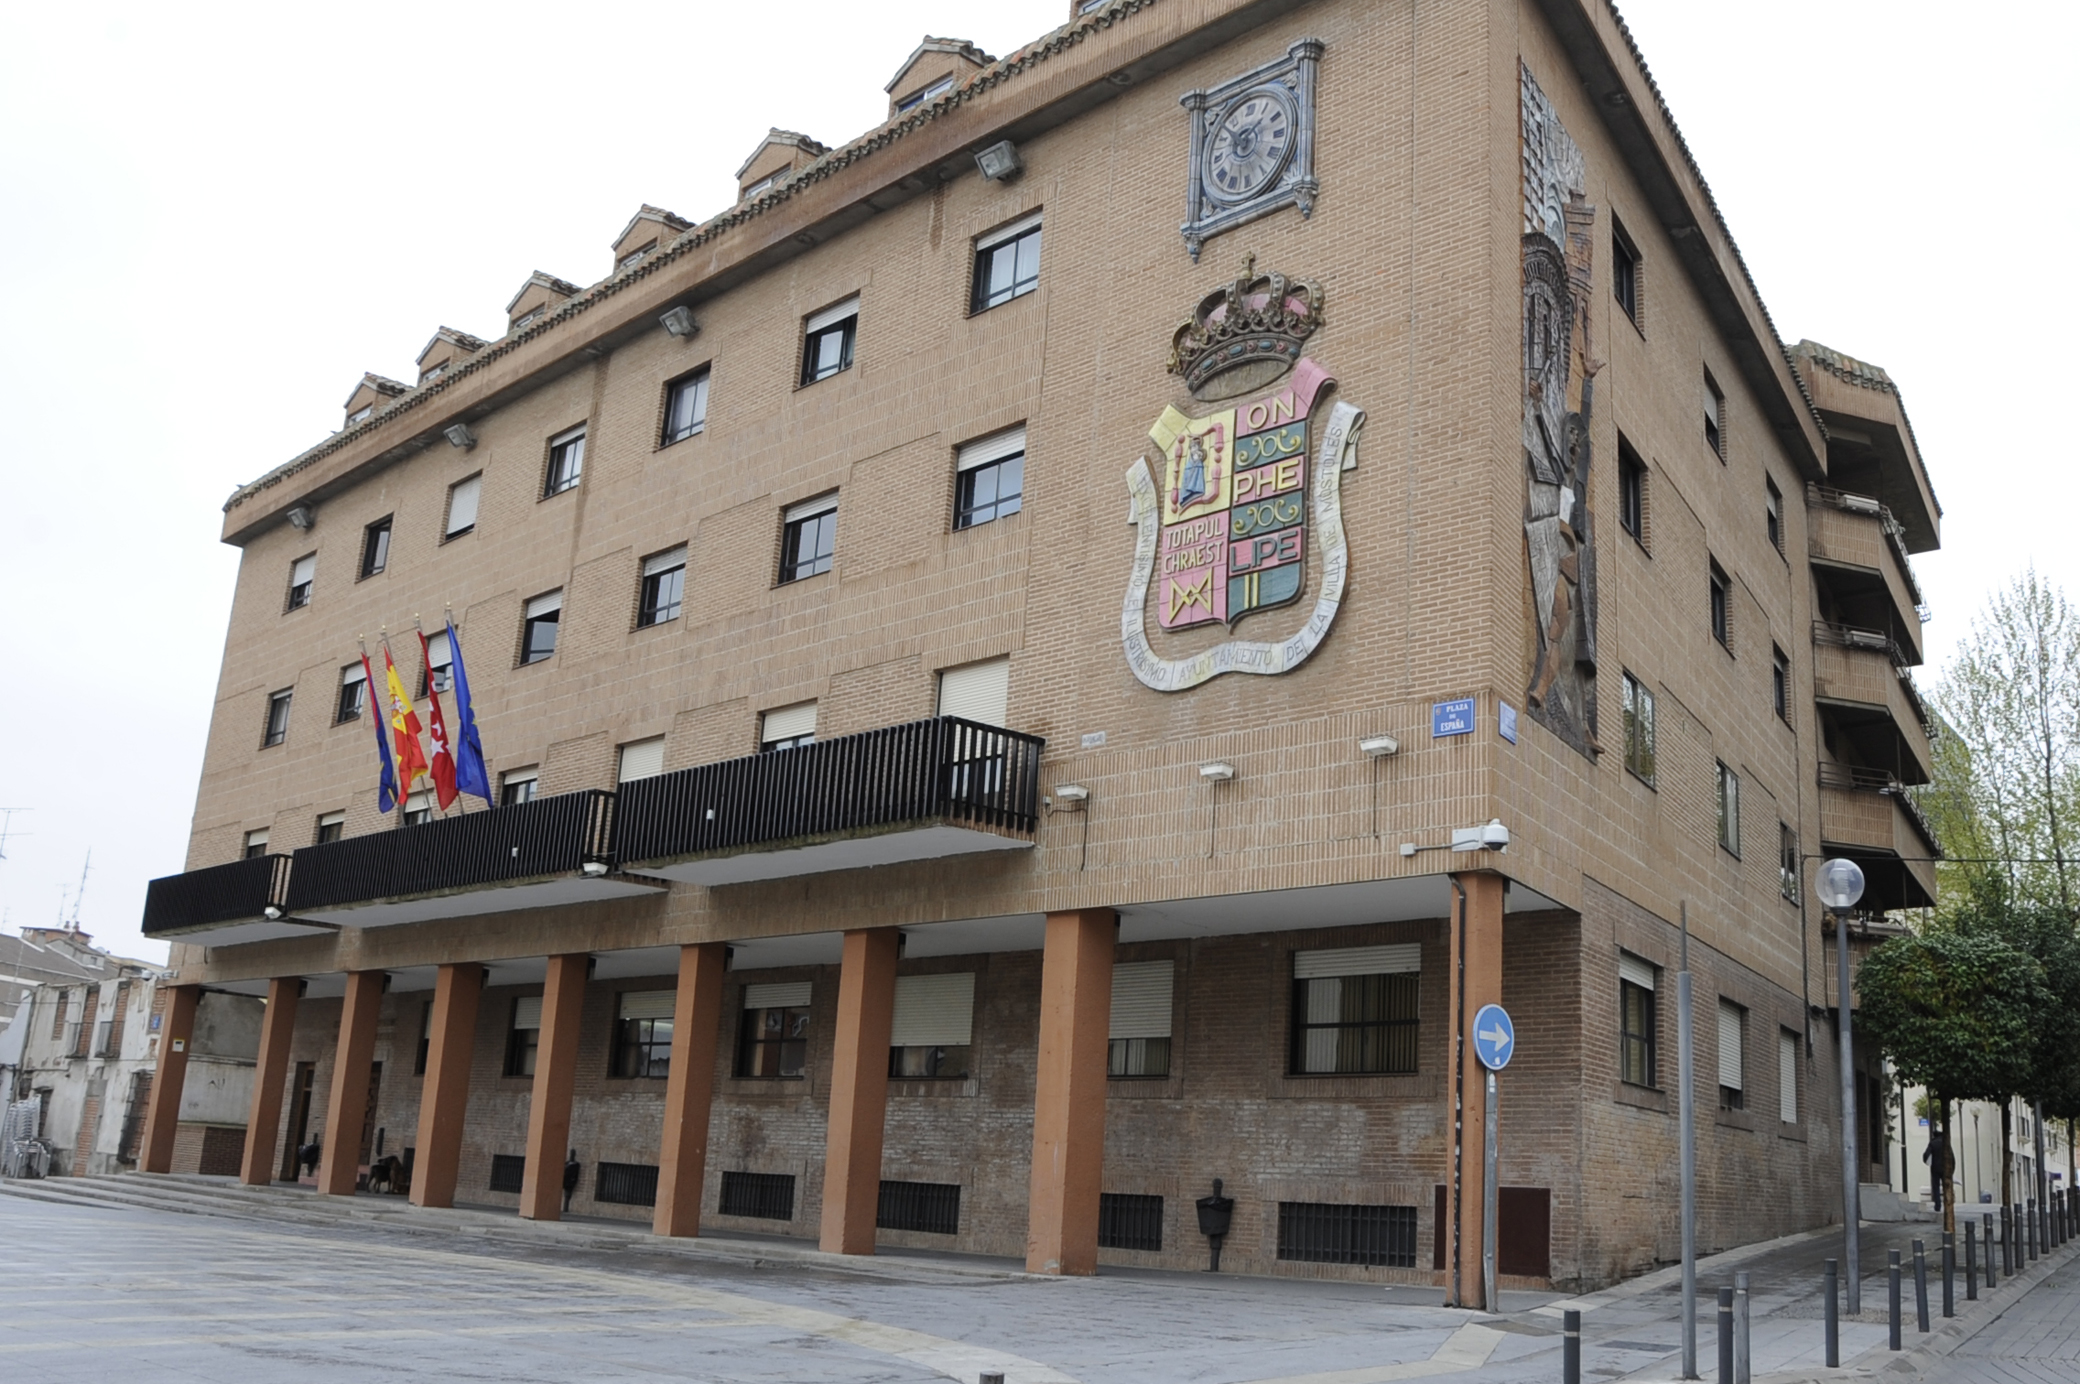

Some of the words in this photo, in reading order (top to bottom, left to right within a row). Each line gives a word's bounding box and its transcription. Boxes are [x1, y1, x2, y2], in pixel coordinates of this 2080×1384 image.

[1247, 391, 1296, 429] ON
[1233, 458, 1300, 503] PHE
[1320, 426, 1342, 513] MOSTOLES
[1165, 517, 1224, 550] TOTAPUL
[1324, 525, 1338, 547] DE
[1163, 541, 1224, 575] CHRAEST
[1230, 530, 1299, 573] LIPE
[1324, 555, 1341, 597] VILLA
[1309, 614, 1328, 637] LA
[1178, 648, 1272, 683] AYUNTAMIENTO
[1286, 639, 1304, 662] DE
[1441, 719, 1464, 731] ESPAÑA
[1446, 703, 1468, 713] PLAZA
